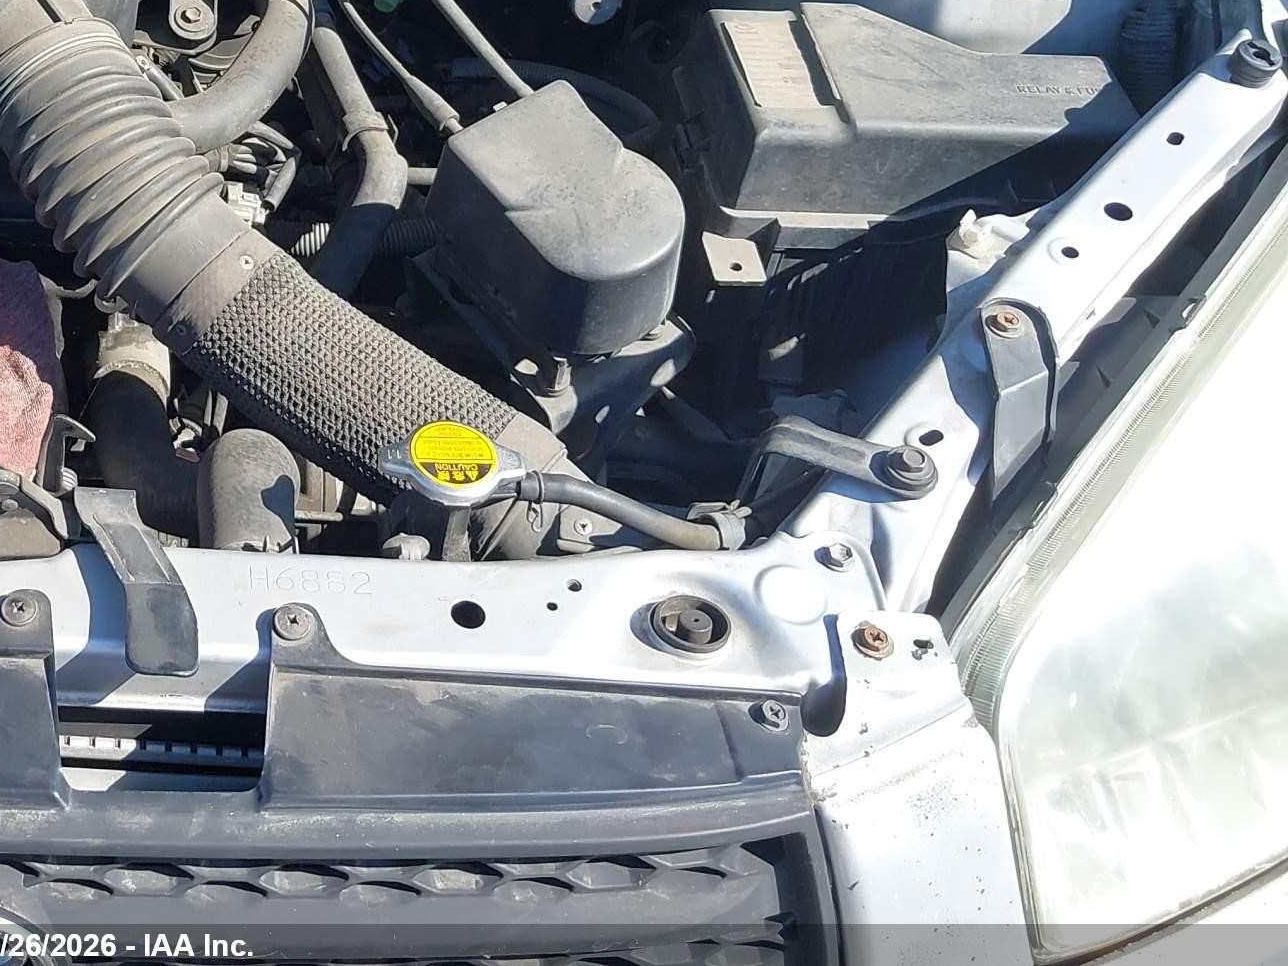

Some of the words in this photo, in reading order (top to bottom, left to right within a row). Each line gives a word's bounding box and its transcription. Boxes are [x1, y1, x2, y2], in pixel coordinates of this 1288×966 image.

[1016, 84, 1060, 95] RELAY
[434, 463, 479, 471] CAUTION
[248, 564, 373, 595] H6882
